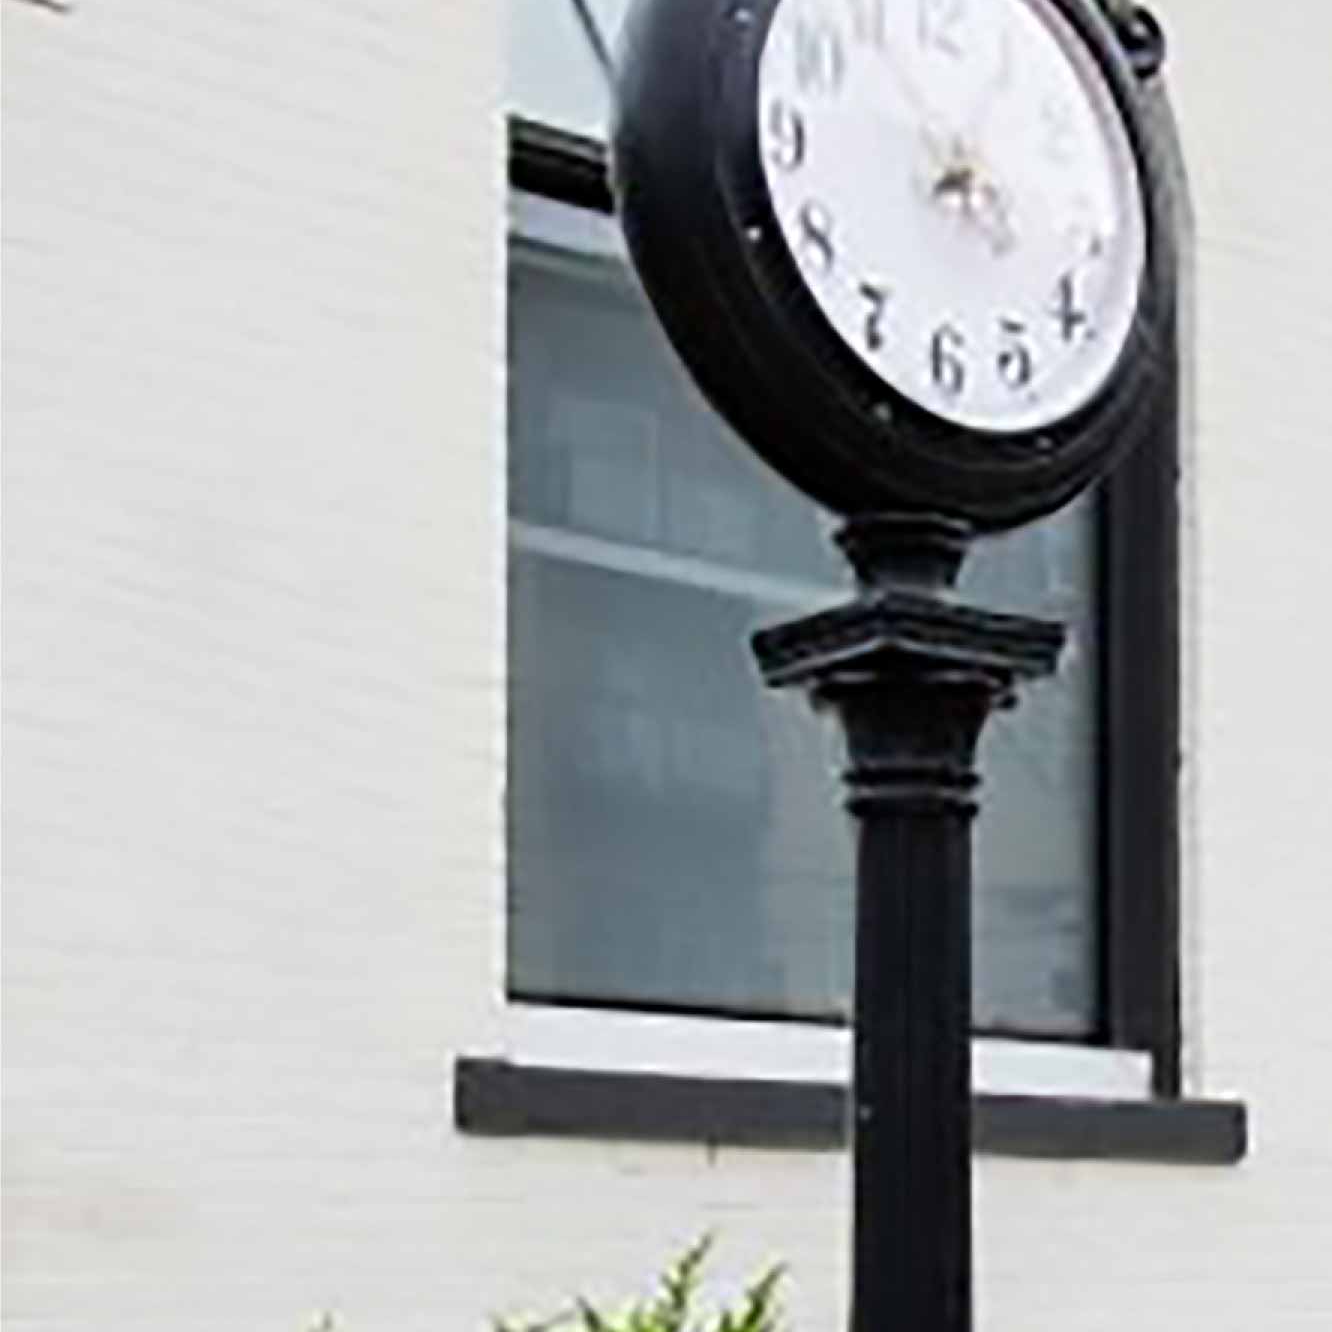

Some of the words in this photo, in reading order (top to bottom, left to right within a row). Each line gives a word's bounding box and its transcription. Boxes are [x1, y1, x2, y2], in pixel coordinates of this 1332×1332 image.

[769, 100, 806, 170] 9
[800, 202, 836, 270] 8
[858, 280, 892, 352] 7
[1048, 270, 1088, 344] 4
[929, 322, 966, 395] 6
[996, 314, 1034, 388] 5
